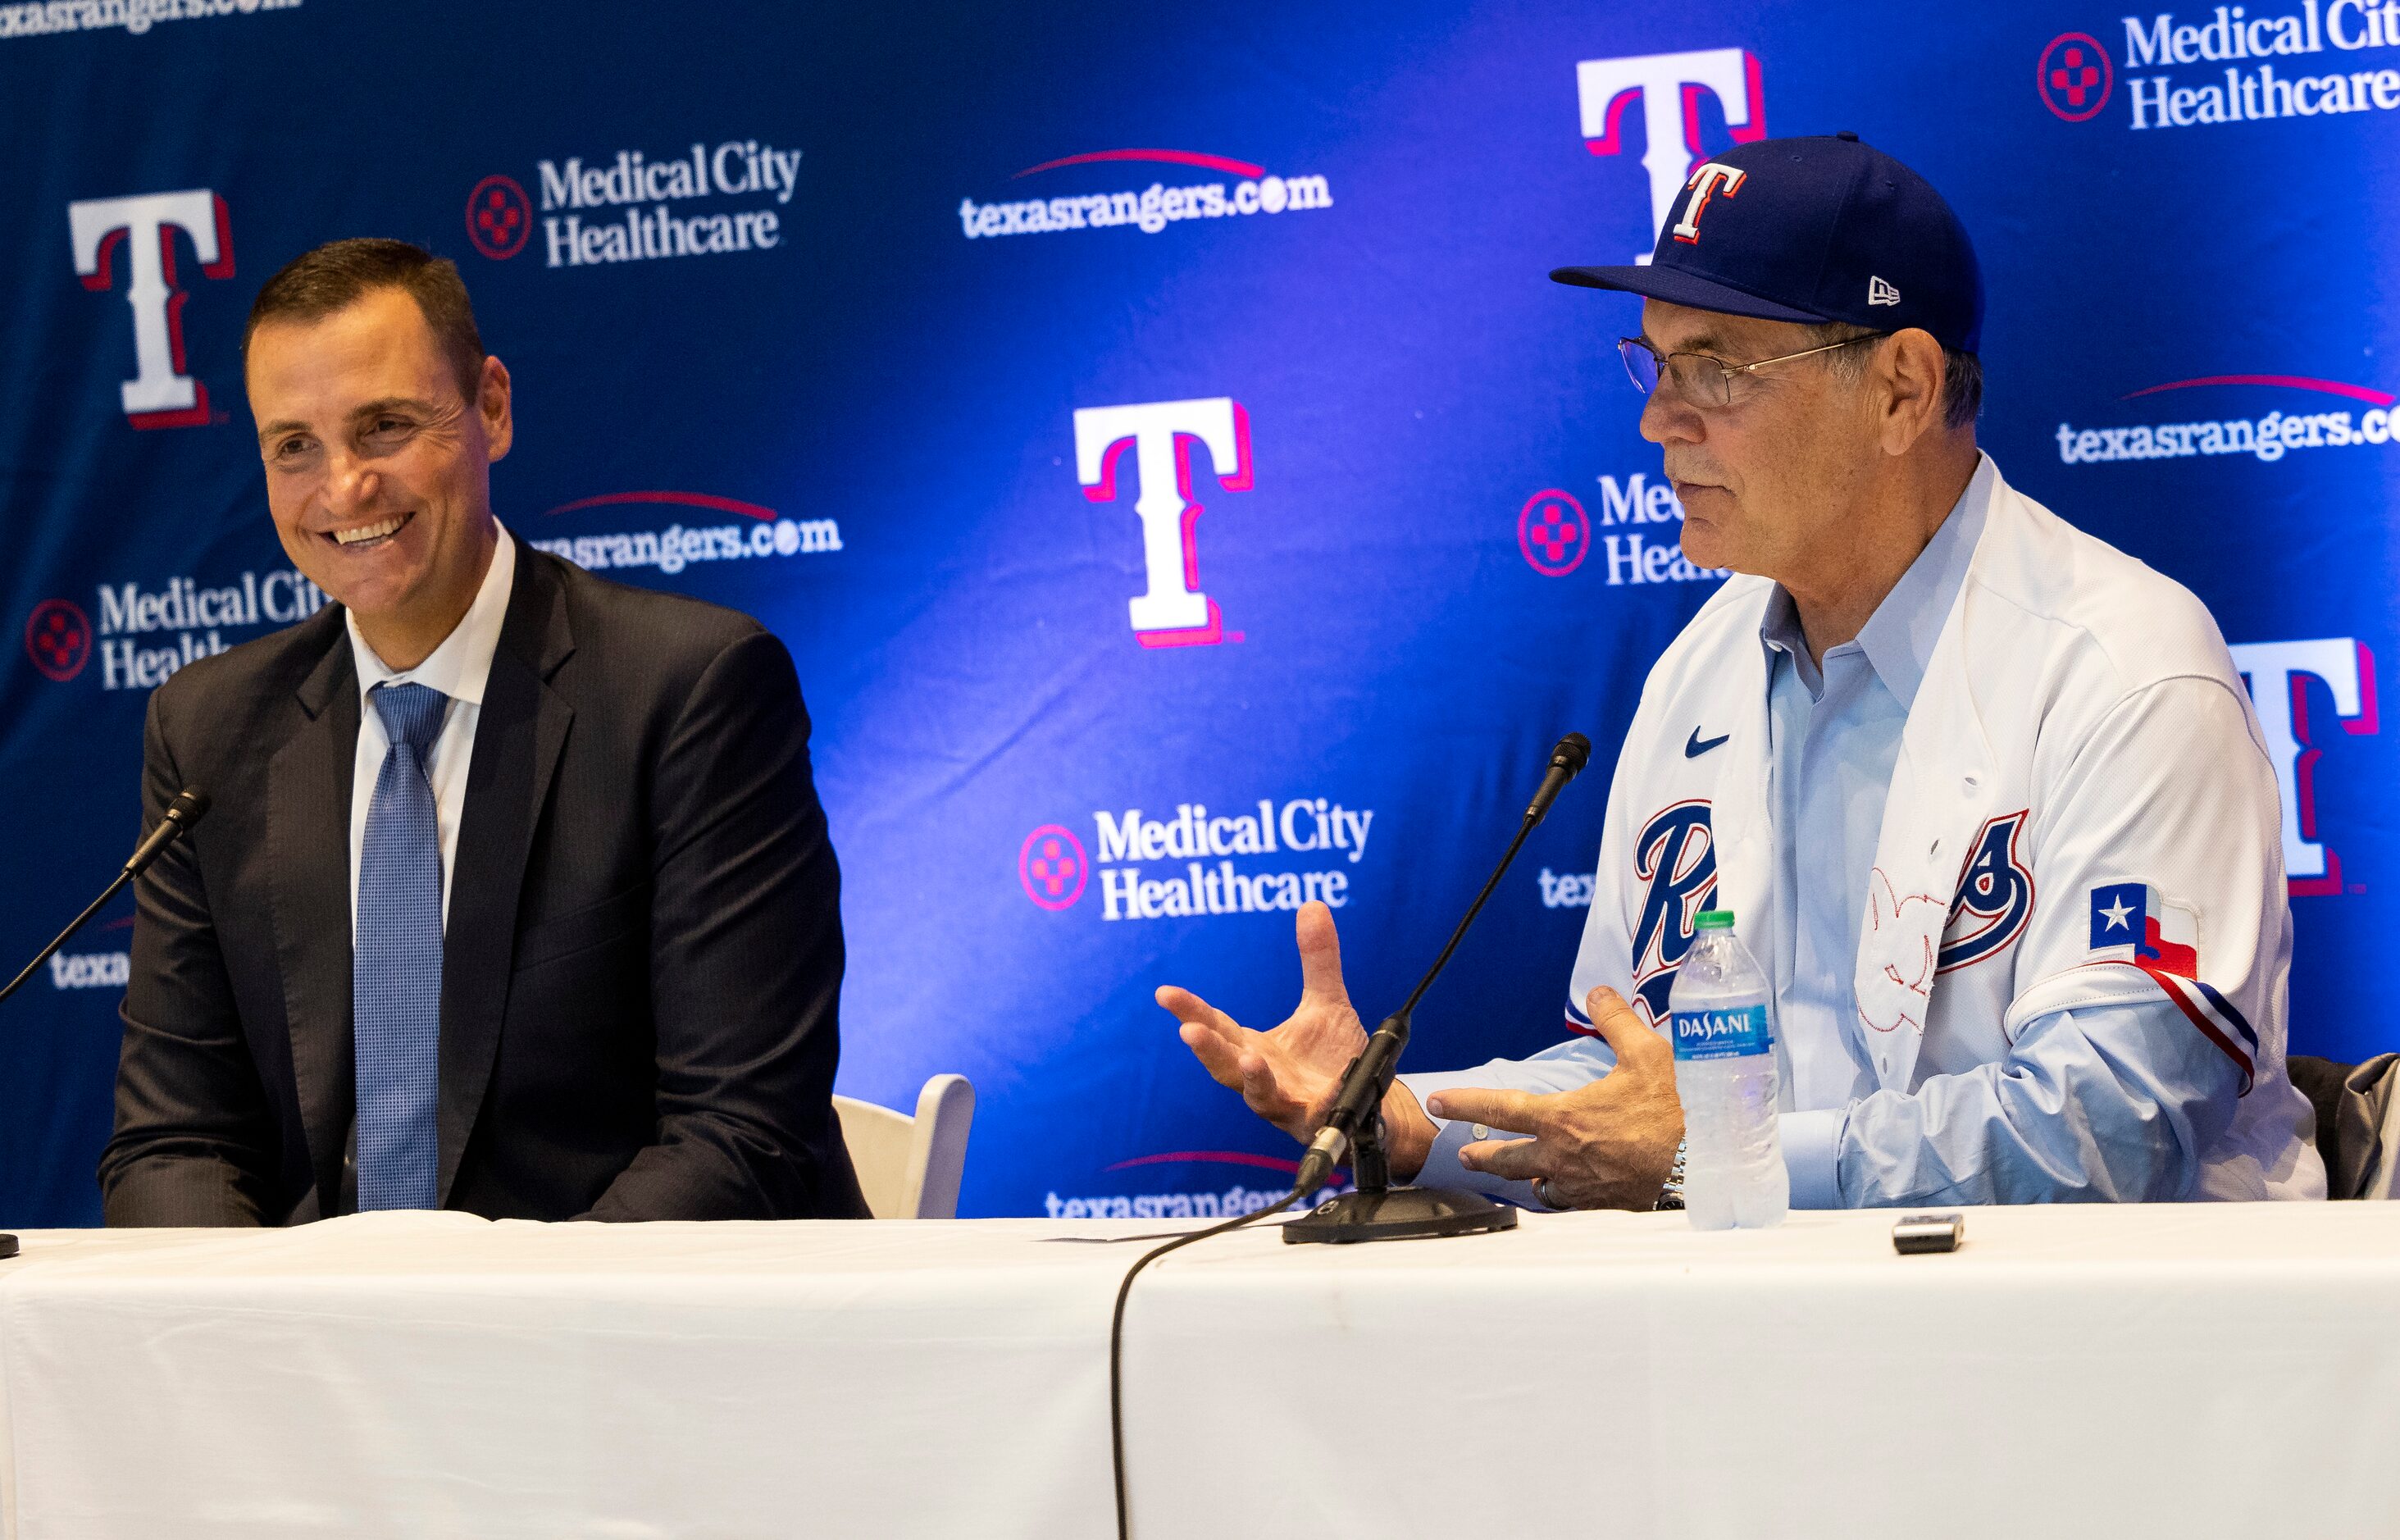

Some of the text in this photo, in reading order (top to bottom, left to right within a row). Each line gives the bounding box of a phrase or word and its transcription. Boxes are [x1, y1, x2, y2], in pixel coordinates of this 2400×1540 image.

[2121, 2, 2323, 67] Medical
[2127, 64, 2400, 130] Healthcare
[538, 139, 802, 211] Medical City
[1576, 48, 1767, 267] T
[541, 205, 780, 267] Healthcare
[959, 174, 1334, 239] texasrangers.com
[1673, 162, 1747, 245] T
[68, 188, 236, 431] T
[1073, 397, 1254, 649] T
[1603, 533, 1733, 585] Hea
[98, 569, 333, 636] Medical Cit
[1092, 797, 1374, 863] Medical City
[1099, 860, 1349, 922] Healthcare
[1678, 1012, 1751, 1041] DASANI
